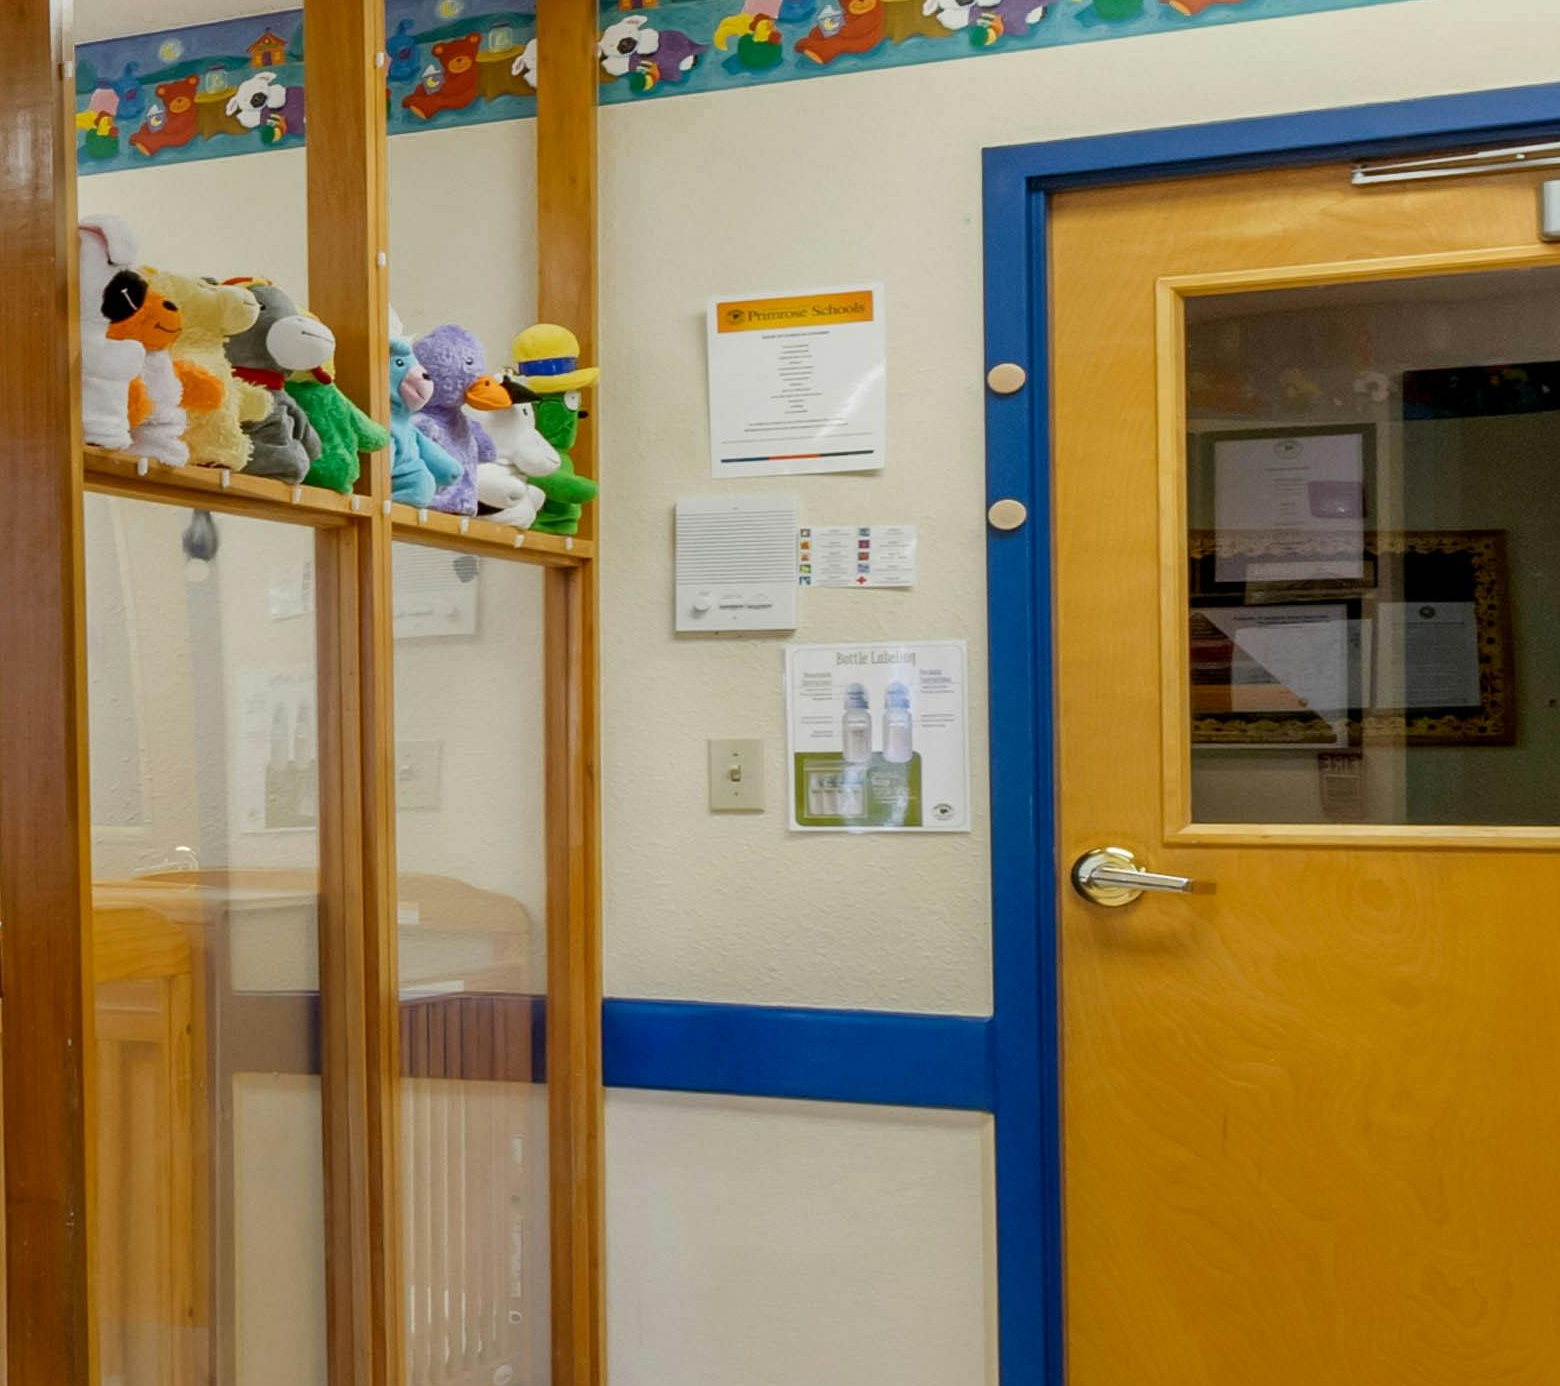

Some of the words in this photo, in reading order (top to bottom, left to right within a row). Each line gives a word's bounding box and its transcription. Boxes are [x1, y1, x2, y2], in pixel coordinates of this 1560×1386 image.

[748, 308, 808, 322] Primrose
[811, 301, 865, 317] Schools
[835, 650, 869, 666] Bottle
